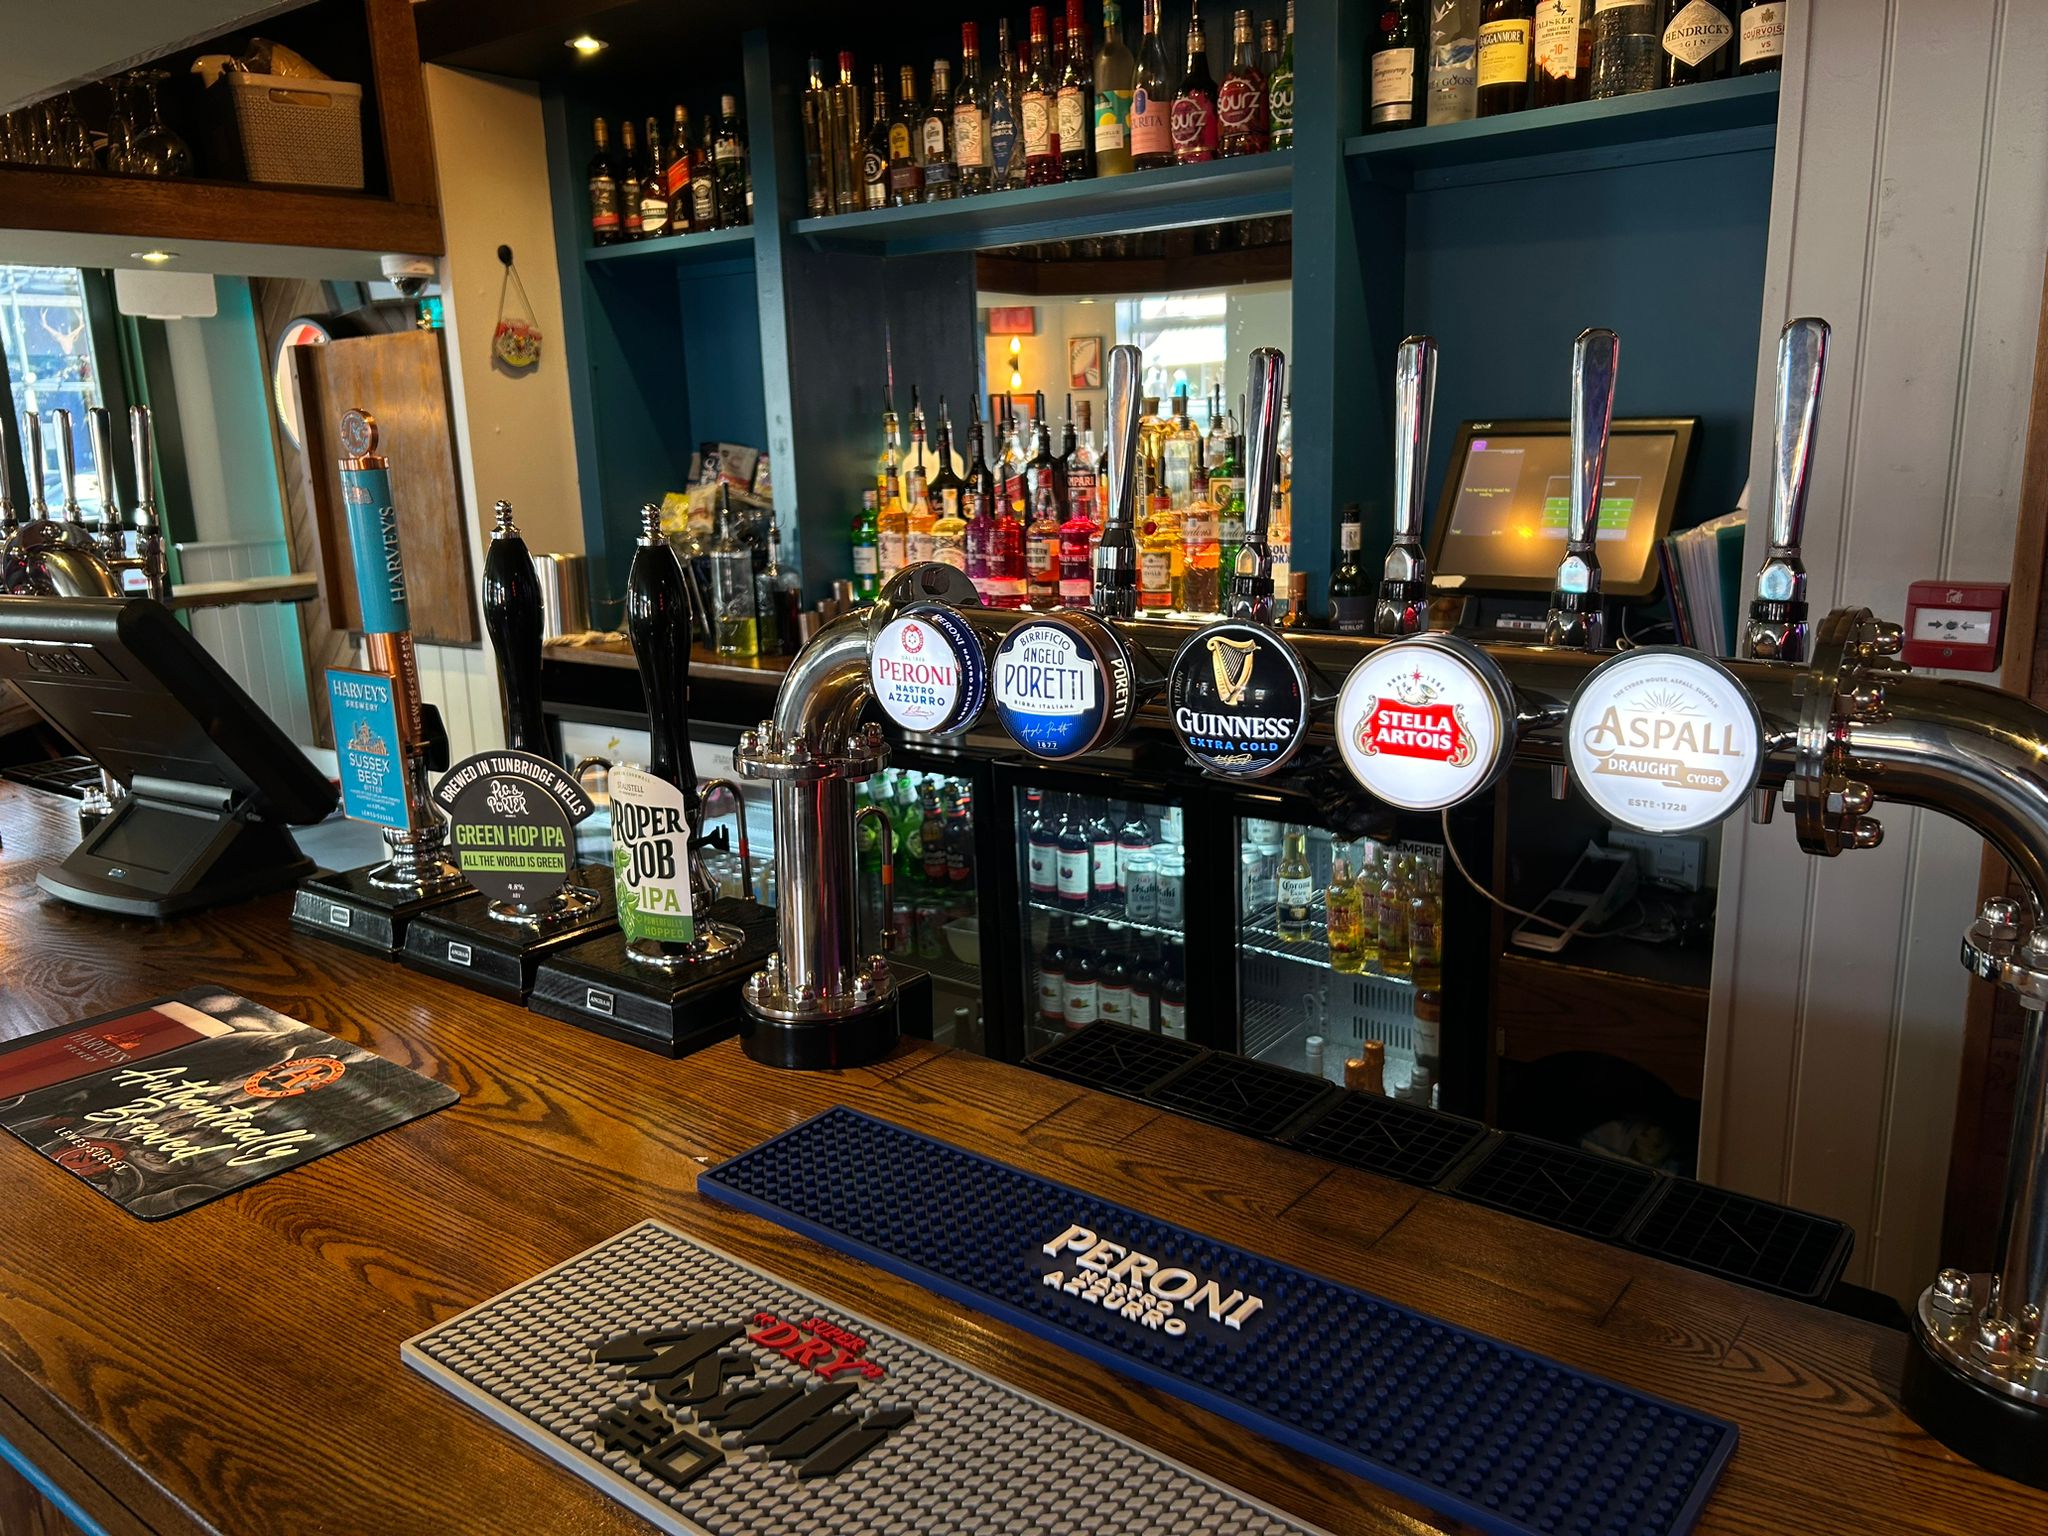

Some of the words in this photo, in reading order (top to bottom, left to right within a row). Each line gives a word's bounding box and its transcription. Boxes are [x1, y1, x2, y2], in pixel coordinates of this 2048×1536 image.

[1665, 24, 1730, 43] HENDRICK'S
[1685, 39, 1706, 48] GIN
[1554, 44, 1563, 55] 10
[1442, 75, 1475, 86] GOOSE
[379, 505, 405, 602] HARVEY'S
[932, 613, 965, 645] PERONI
[1020, 631, 1071, 651] BIRRIFICIO
[1024, 648, 1064, 666] ANGELO
[879, 658, 952, 686] PERONI
[333, 680, 388, 704] HARVEY'S
[895, 684, 935, 695] NASTRO
[1005, 664, 1084, 701] PORETTI
[1110, 658, 1129, 719] PORETTI
[346, 700, 379, 712] BREWERY
[889, 693, 945, 706] AZZURRO
[1014, 700, 1035, 708] BIRRA
[1038, 702, 1074, 710] ITALIANA
[1176, 707, 1294, 739] GUINNESS
[1378, 710, 1452, 733] STELLA
[1584, 705, 1742, 758] ASPALL
[1190, 736, 1234, 750] EXTRA
[1240, 742, 1279, 751] COLD
[1376, 730, 1452, 750] ARTOIS
[349, 753, 390, 773] SUSSEX
[1608, 758, 1678, 776] DRAUGHT
[1687, 773, 1722, 786] CYDER
[357, 770, 384, 786] BEST
[441, 768, 477, 803] BREWED
[478, 760, 490, 776] IN
[491, 757, 555, 787] TUNBRIDGE
[553, 782, 587, 817] WELLS
[364, 785, 383, 794] BITTER
[487, 796, 529, 815] PORTER
[1662, 801, 1687, 812] 1728
[610, 797, 686, 848] PROPER
[455, 824, 504, 847] GREEN
[508, 825, 538, 847] HOP
[542, 826, 566, 848] IPA
[1396, 842, 1442, 858] EMPIRE
[463, 854, 477, 867] ALL
[478, 855, 495, 867] THE
[496, 856, 526, 868] WORLD
[527, 857, 535, 869] IS
[536, 857, 564, 869] GREEN
[626, 839, 676, 888] JOB
[508, 883, 525, 891] 4.8%
[1282, 880, 1310, 890] Corona
[642, 886, 681, 912] IPA
[644, 916, 683, 927] POWERFULLY
[644, 924, 685, 938] HOPPED
[63, 1044, 98, 1063] BREWERY
[69, 1032, 131, 1063] HARVEY'S
[111, 1066, 316, 1167] Authentically
[83, 1096, 235, 1164] Brewed
[1042, 1224, 1263, 1331] PERONI
[1043, 1270, 1187, 1335] AZZURRO
[1078, 1269, 1174, 1317] NASTRO
[801, 1317, 868, 1353] SUPER
